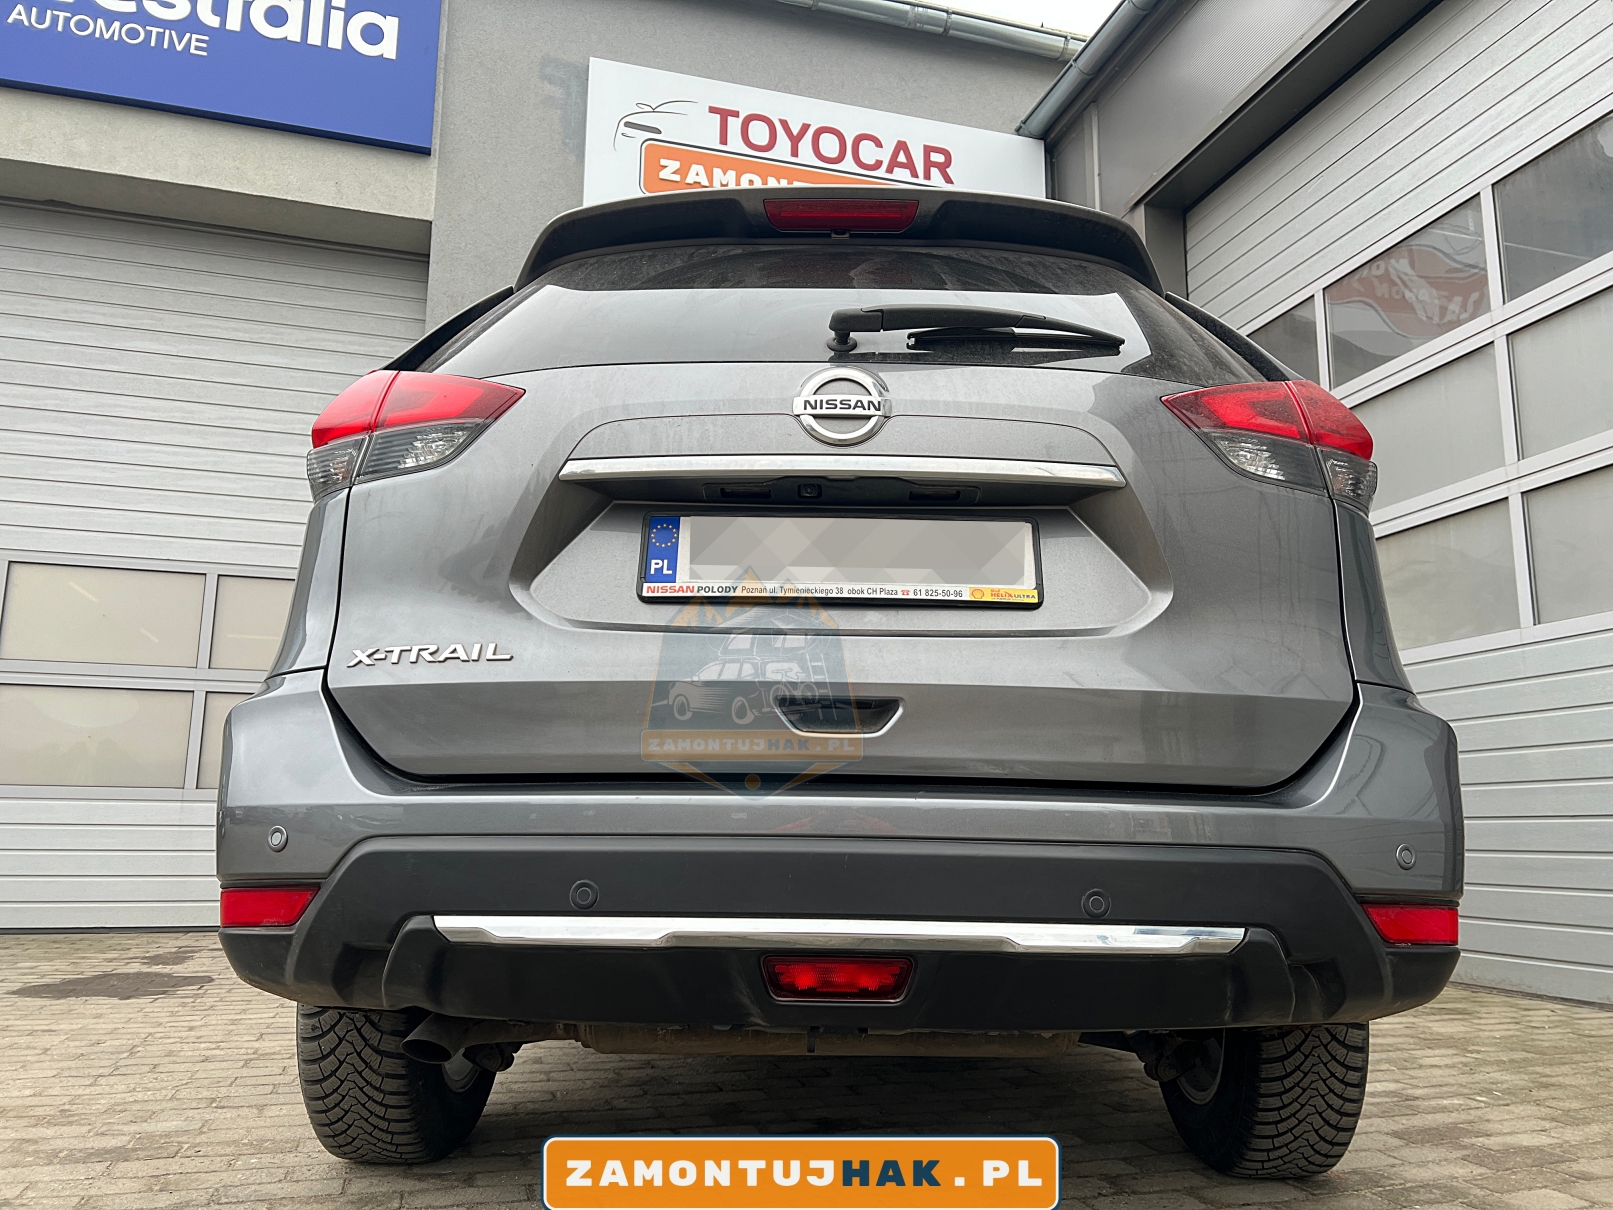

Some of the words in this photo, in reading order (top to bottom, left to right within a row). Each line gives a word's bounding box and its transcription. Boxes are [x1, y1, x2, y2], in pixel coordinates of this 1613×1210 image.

[7, 3, 210, 56] AUTOMOTIVE
[708, 105, 955, 185] TOYOCAR
[658, 158, 814, 188] ZAMO
[803, 399, 881, 411] NISSAN
[650, 559, 673, 575] PL
[646, 585, 695, 594] NISSAN
[697, 585, 738, 594] POLODY
[741, 585, 767, 594] Poznań
[769, 586, 778, 594] ul.
[780, 586, 834, 596] Tymienieckiego
[835, 587, 844, 595] 38
[847, 587, 865, 595] obok
[866, 587, 878, 595] CH
[879, 588, 898, 596] Plaza
[913, 589, 922, 597] 61
[924, 589, 963, 598] 825-50-96
[346, 642, 513, 668] X-TRAIL
